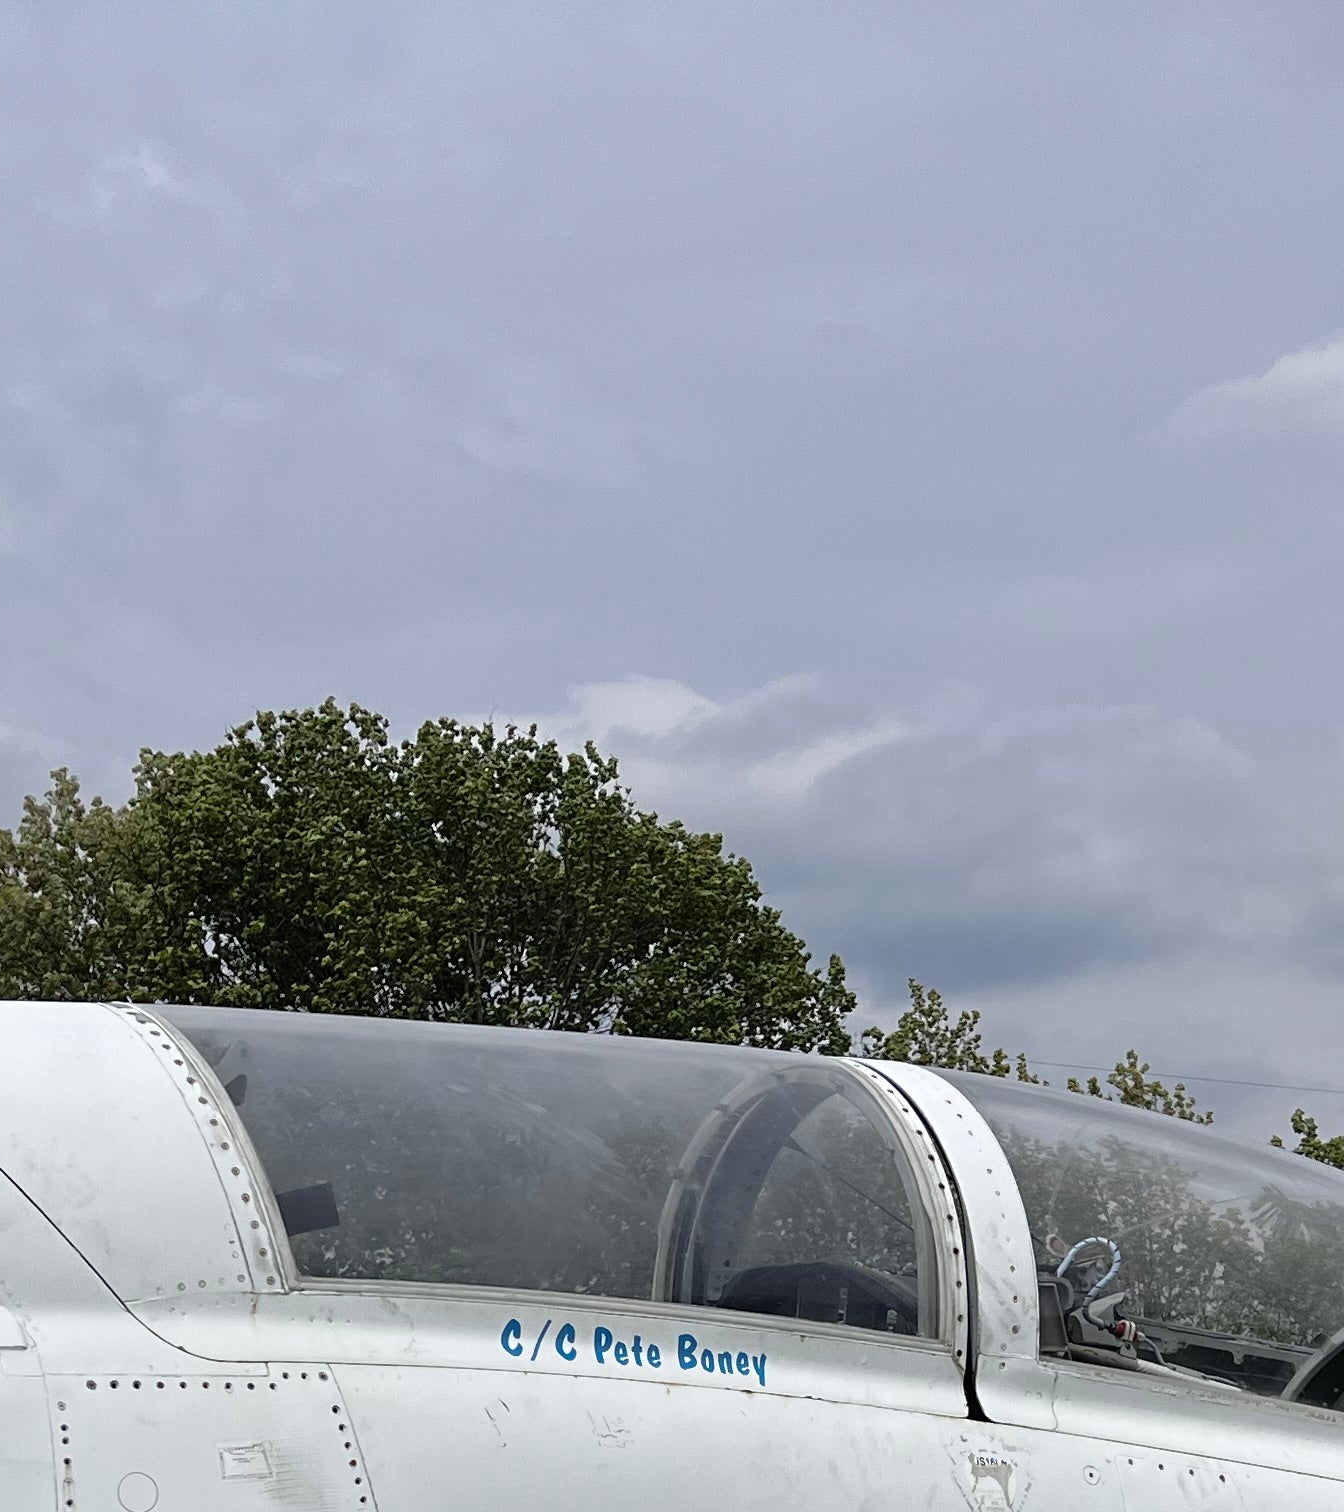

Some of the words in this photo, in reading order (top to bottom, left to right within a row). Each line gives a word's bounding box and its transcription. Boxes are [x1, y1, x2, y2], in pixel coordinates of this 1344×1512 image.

[500, 1318, 577, 1362] C/C
[593, 1326, 662, 1368] Pete
[677, 1333, 767, 1386] Boney
